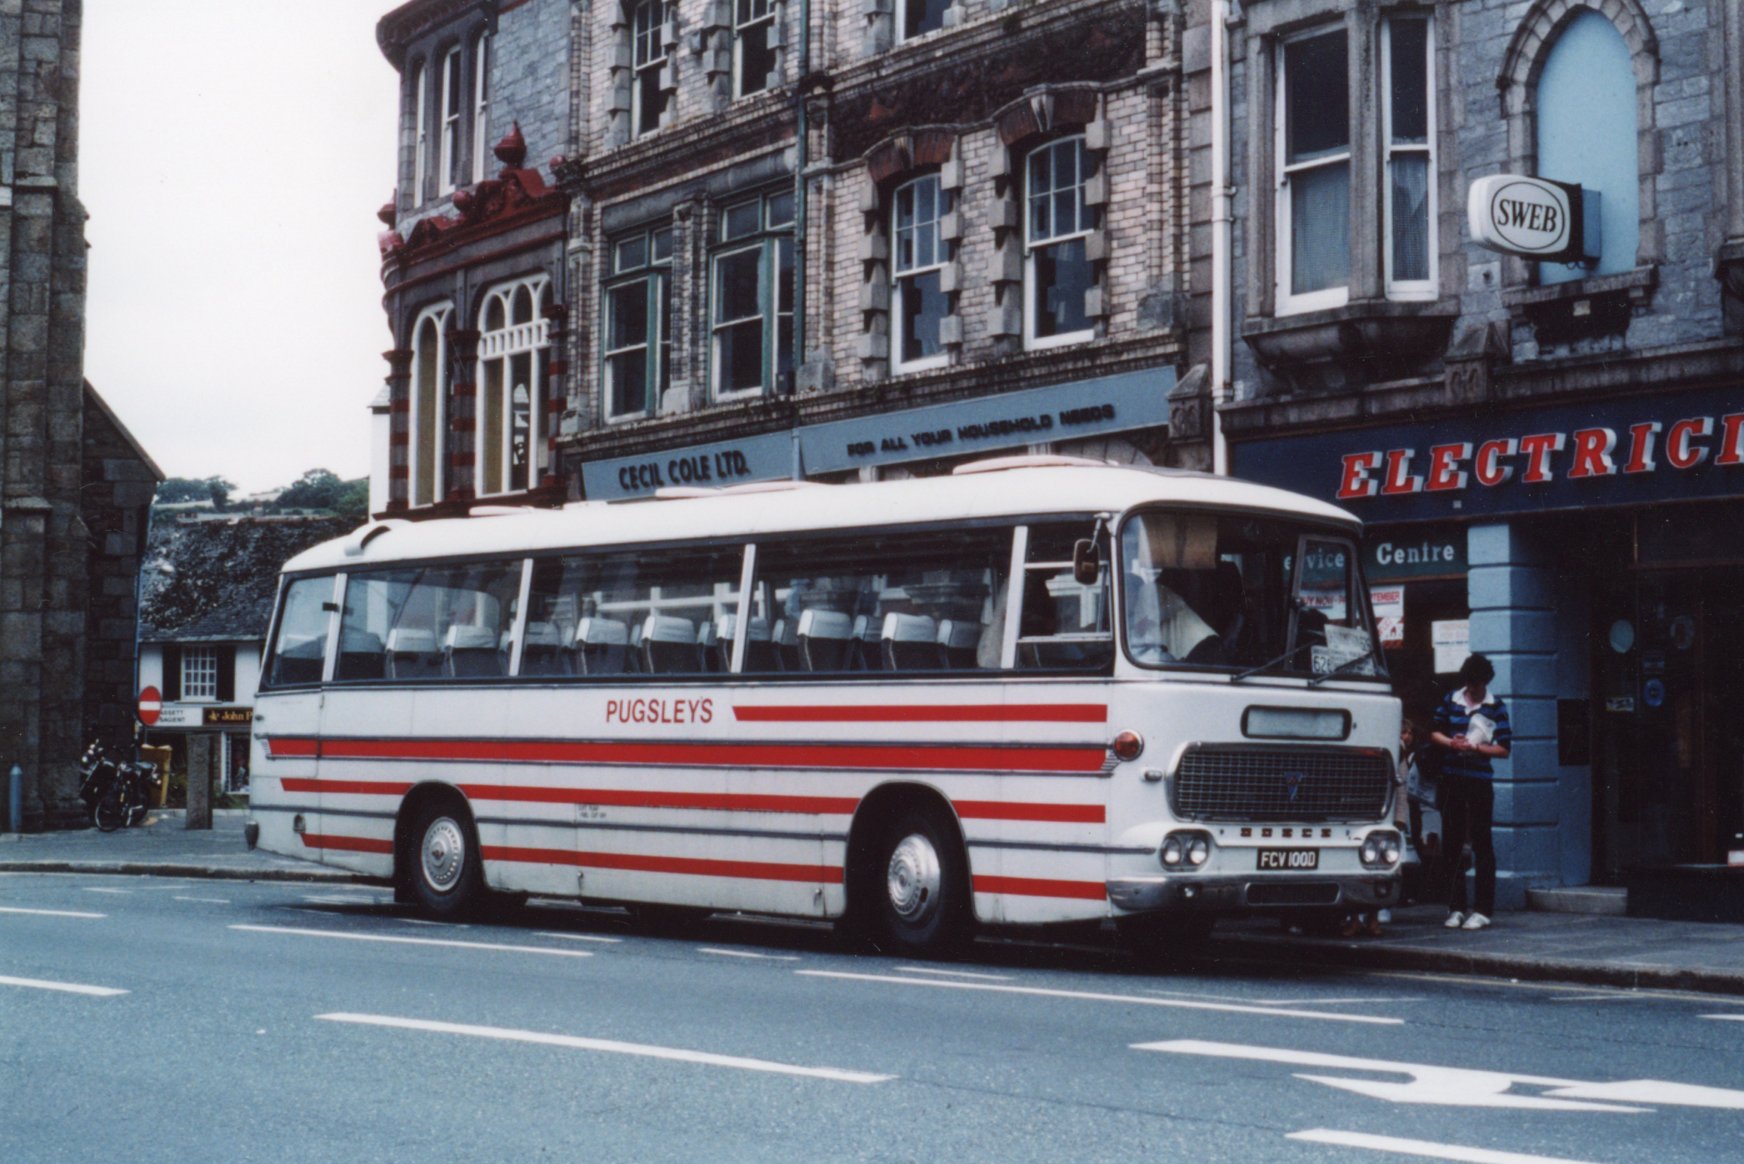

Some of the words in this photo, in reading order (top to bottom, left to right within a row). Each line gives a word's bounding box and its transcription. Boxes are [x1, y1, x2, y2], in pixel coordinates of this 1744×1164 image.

[1497, 199, 1557, 232] SWEB
[847, 440, 876, 456] FOR
[881, 436, 908, 452] ALL
[911, 428, 953, 447] YOUR
[958, 413, 1054, 440] HOUSEHOLD
[1059, 403, 1116, 426] NEEDS
[618, 462, 665, 490] CECIL
[668, 455, 711, 484] COLE
[1283, 549, 1345, 571] evice
[1376, 542, 1455, 565] Centre
[1371, 591, 1400, 602] TEMBER
[1261, 851, 1286, 867] FCV
[1288, 851, 1316, 867] 100D
